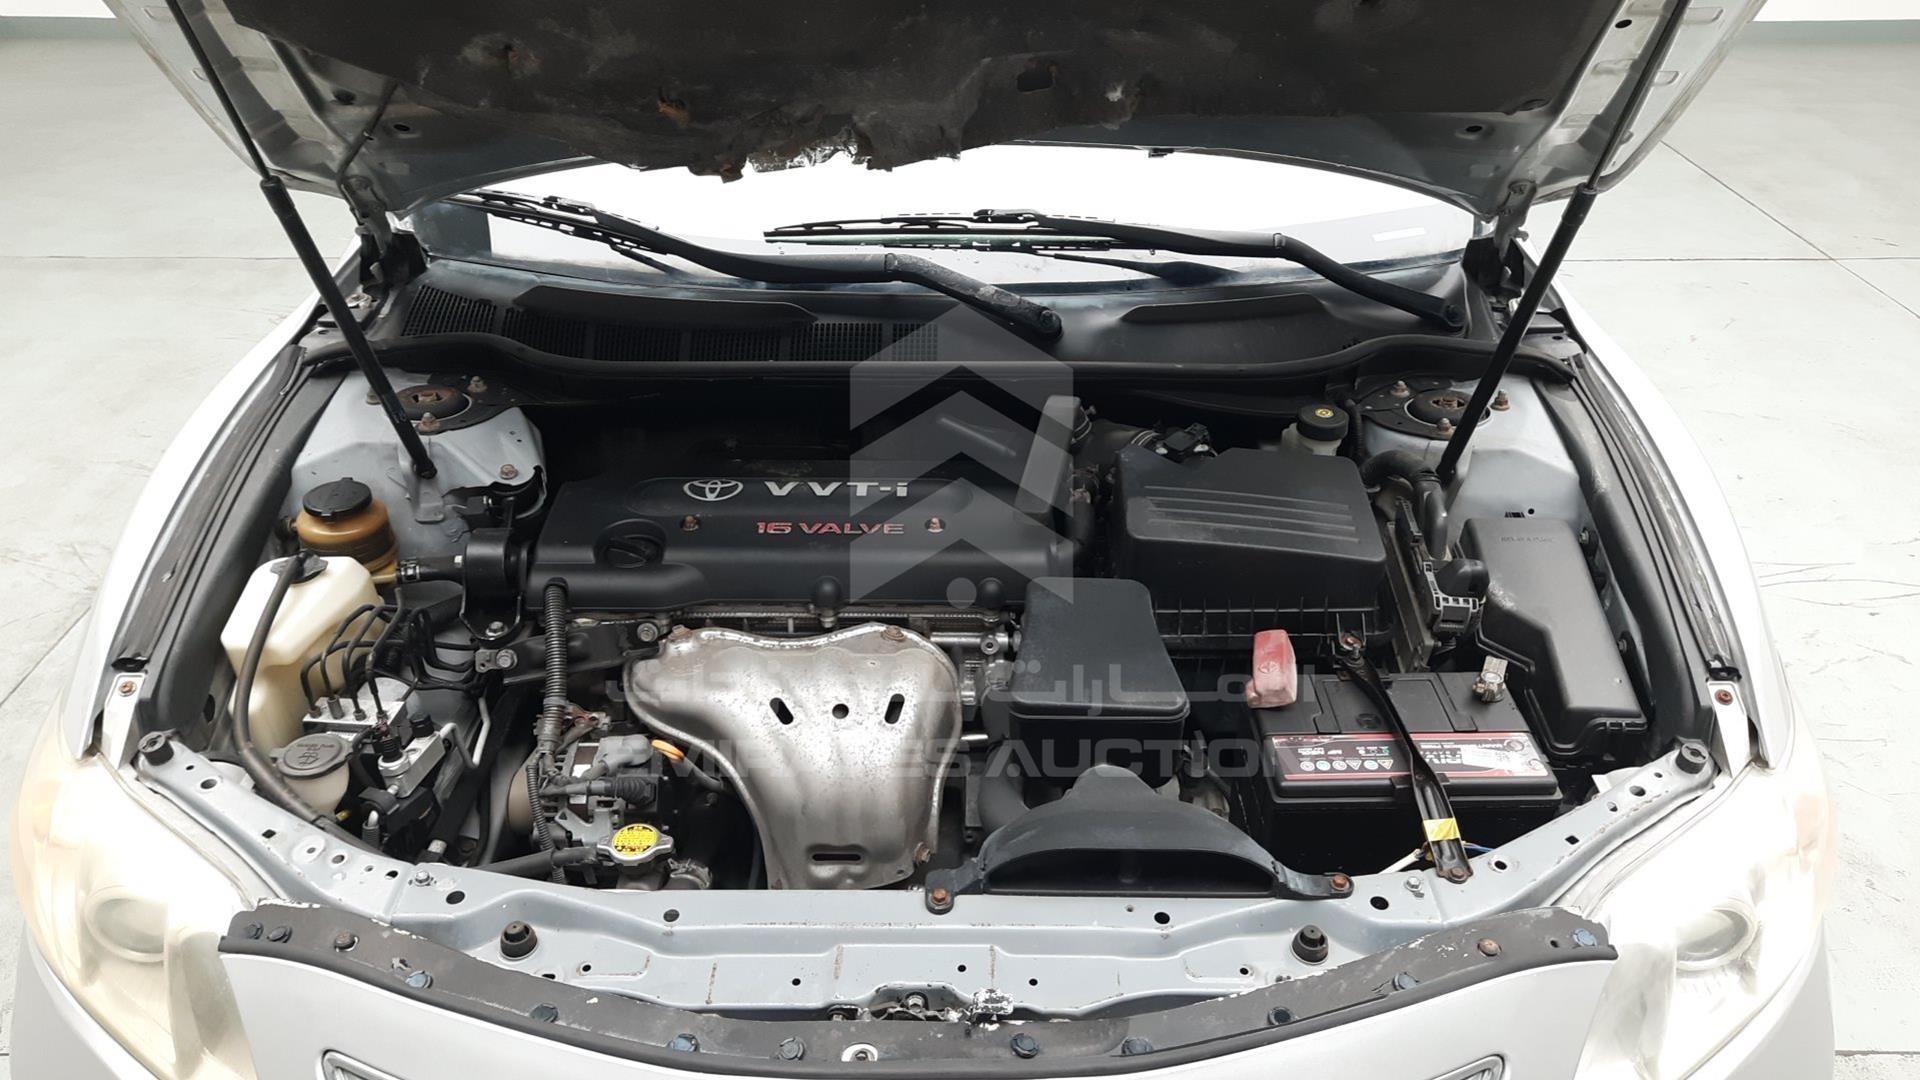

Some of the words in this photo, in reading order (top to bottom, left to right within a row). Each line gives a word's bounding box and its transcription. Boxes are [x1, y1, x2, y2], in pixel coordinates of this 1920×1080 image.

[764, 481, 909, 497] VVT-i
[756, 521, 793, 535] 16
[798, 521, 905, 535] VALVE
